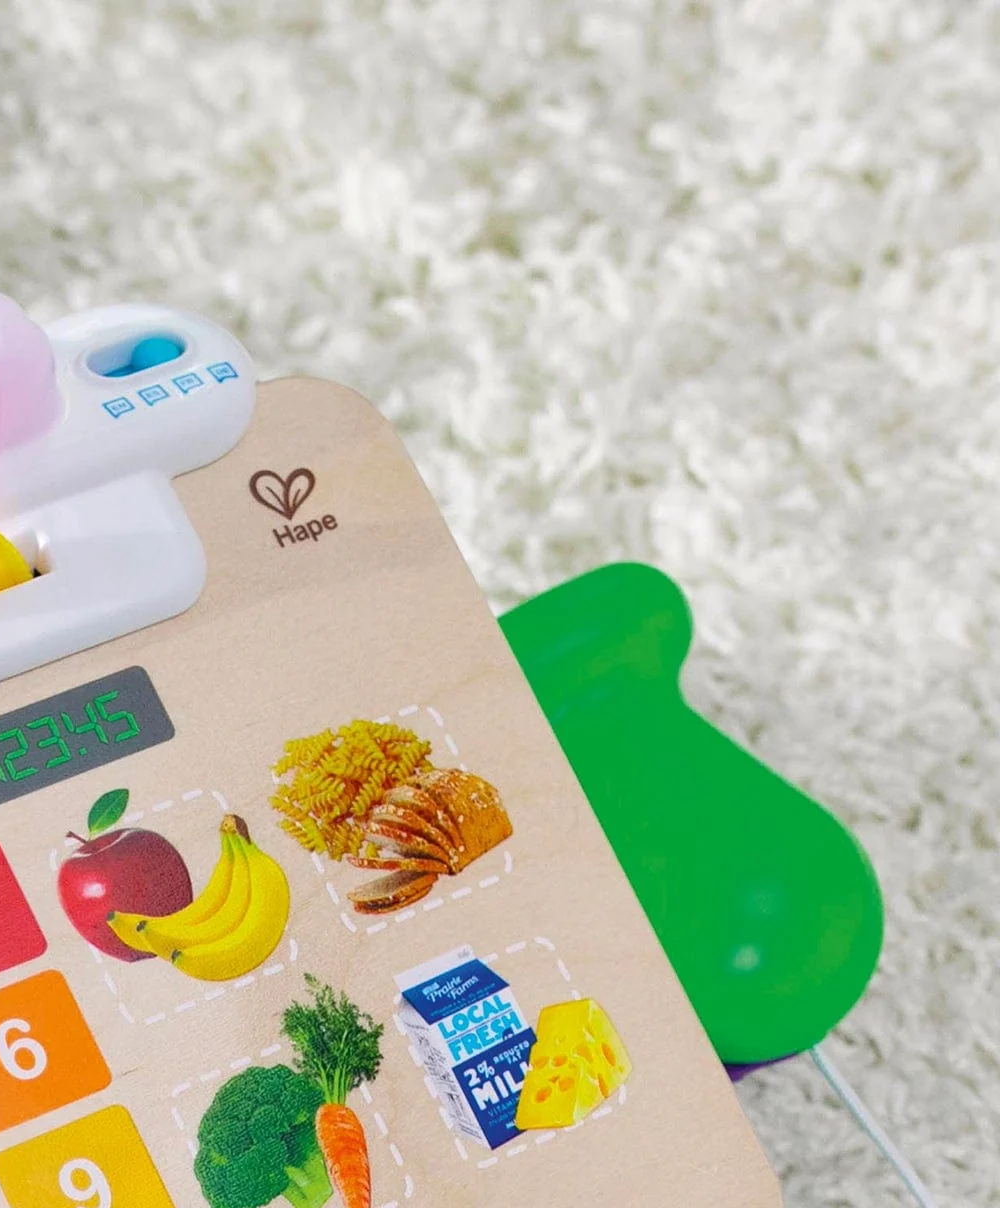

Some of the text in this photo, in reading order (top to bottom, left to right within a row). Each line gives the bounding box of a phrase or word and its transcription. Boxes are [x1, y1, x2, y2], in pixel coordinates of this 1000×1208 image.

[273, 514, 338, 548] Hape
[447, 975, 479, 1000] Farms
[437, 994, 511, 1039] LOCAL
[448, 1010, 522, 1062] FRESH
[493, 1040, 530, 1065] REDUCED
[463, 1060, 495, 1087] 2%
